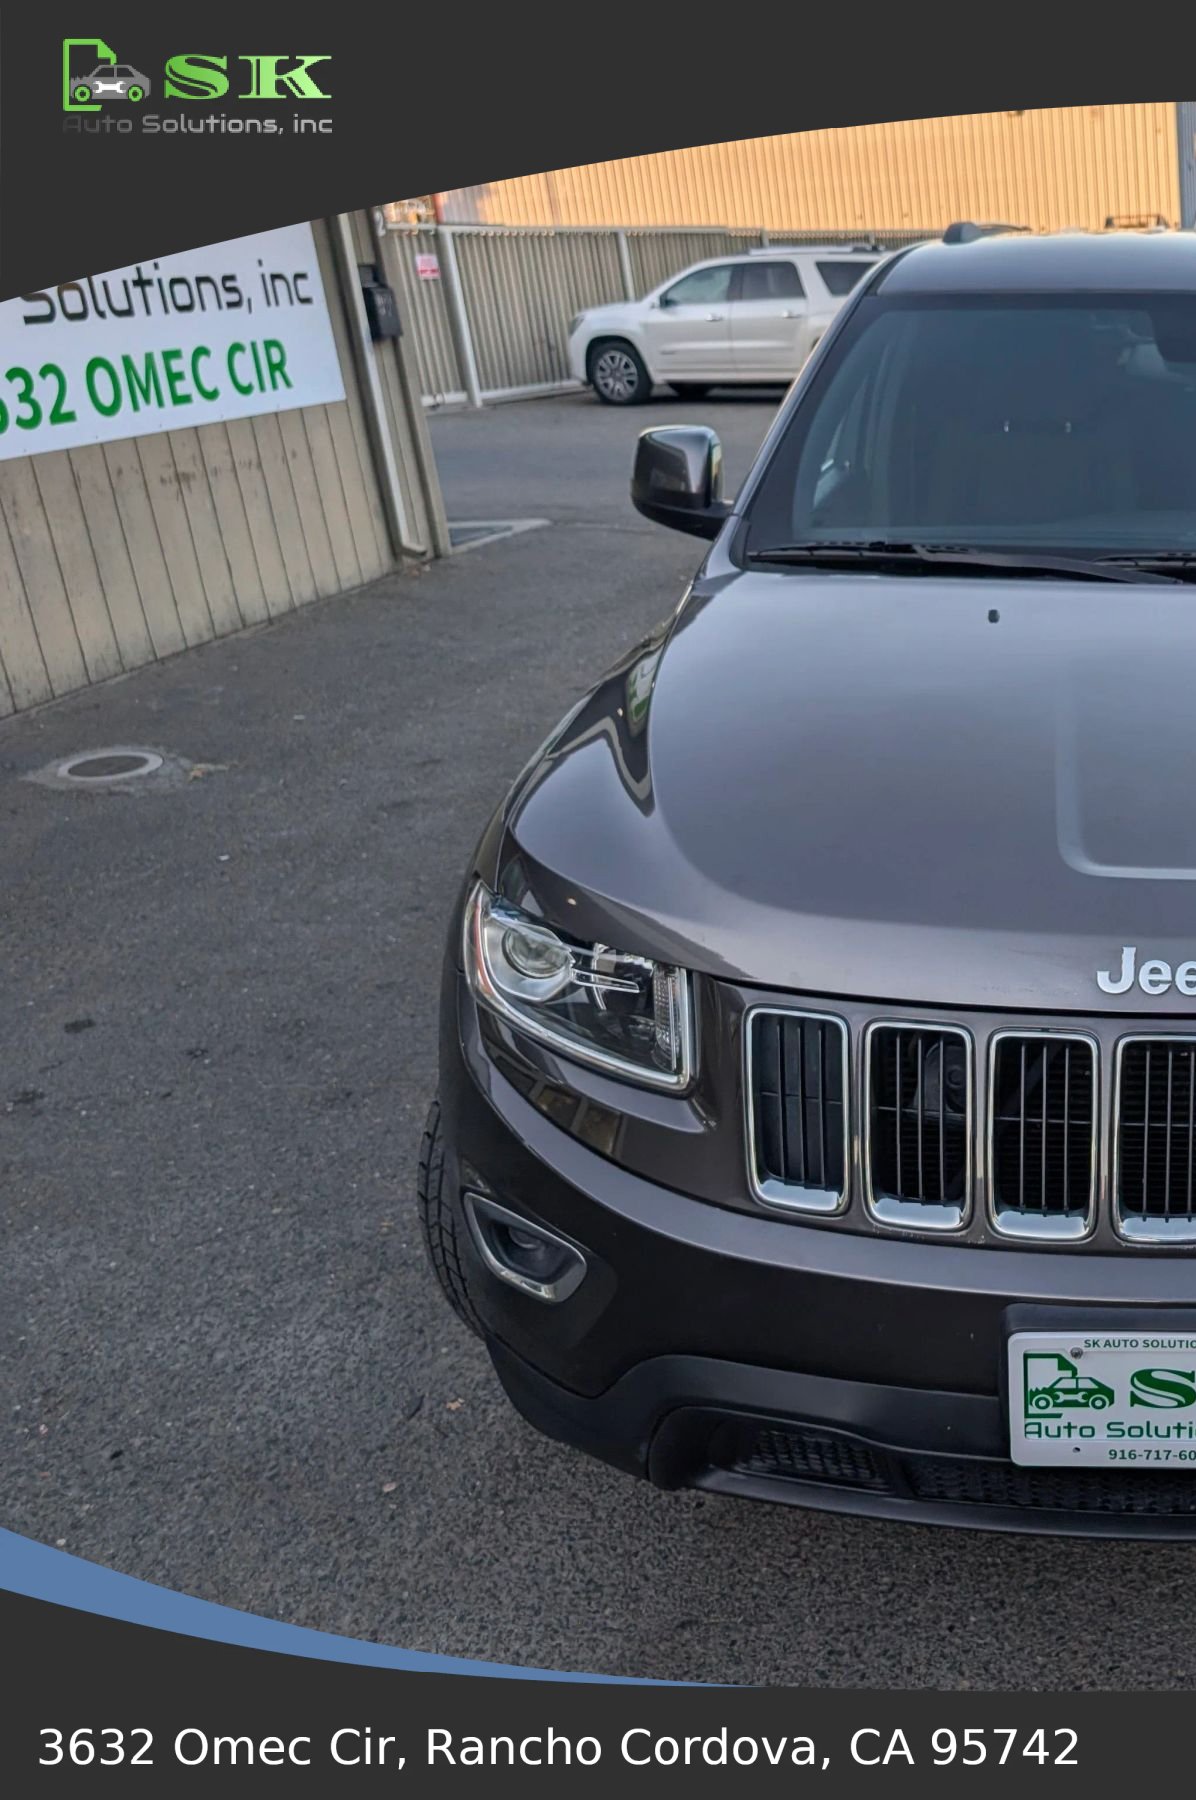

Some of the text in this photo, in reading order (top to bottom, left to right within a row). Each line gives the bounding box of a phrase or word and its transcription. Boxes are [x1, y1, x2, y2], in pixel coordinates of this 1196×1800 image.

[20, 259, 313, 326] Solutions, inc
[0, 339, 293, 434] 32 OMEC CIR
[1084, 1338, 1101, 1349] SK
[1103, 1338, 1139, 1349] AUTO
[1024, 1421, 1096, 1439] Auto
